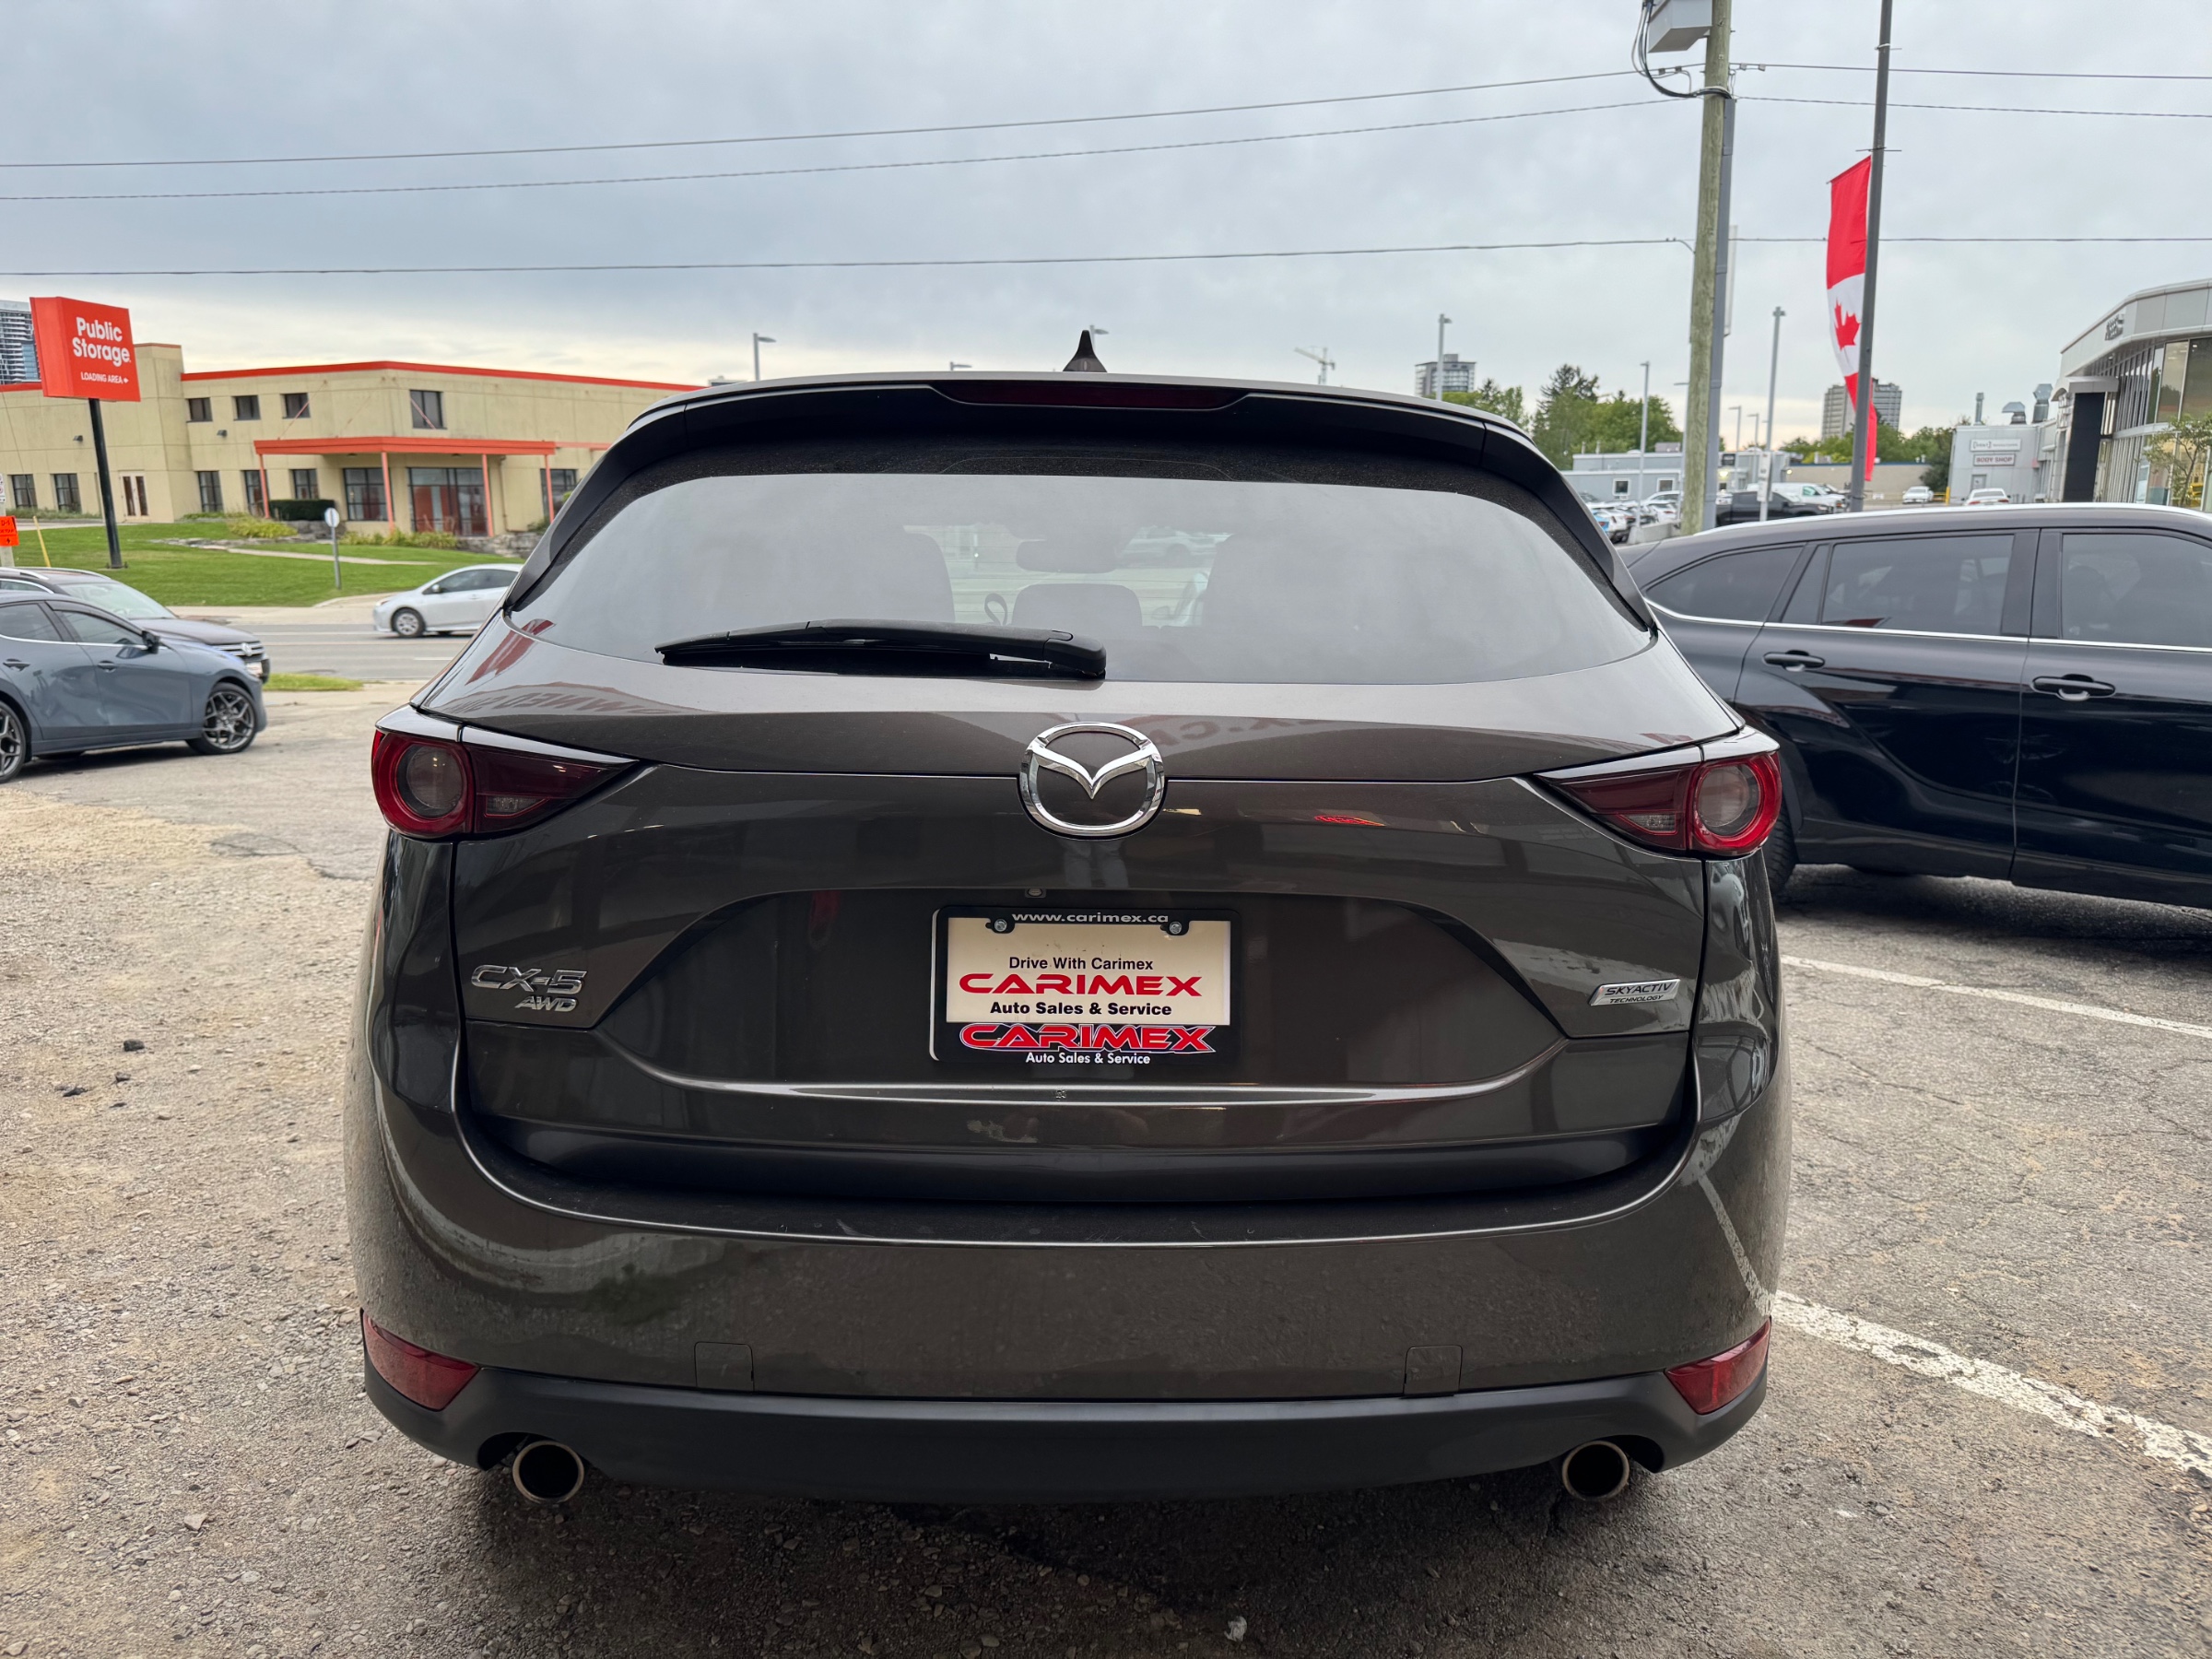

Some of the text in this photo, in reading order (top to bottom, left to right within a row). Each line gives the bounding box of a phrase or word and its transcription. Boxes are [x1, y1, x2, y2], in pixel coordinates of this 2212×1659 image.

[76, 316, 123, 342] Public
[72, 337, 130, 367] Storage
[80, 371, 124, 384] LOADING AREA
[1012, 912, 1169, 923] www.carimex.ca
[1009, 957, 1154, 971] Drive With Carimex
[471, 964, 588, 994] CX-5
[959, 973, 1203, 996] CARIMEX
[1604, 982, 1674, 996] SKYACTIV
[514, 995, 578, 1012] AWD
[1609, 994, 1665, 1004] TECHNOLOGY
[990, 1001, 1172, 1016] Auto Sales & Service
[960, 1023, 1214, 1053] CARIMEX
[1025, 1052, 1151, 1065] Auto Sales & Service
